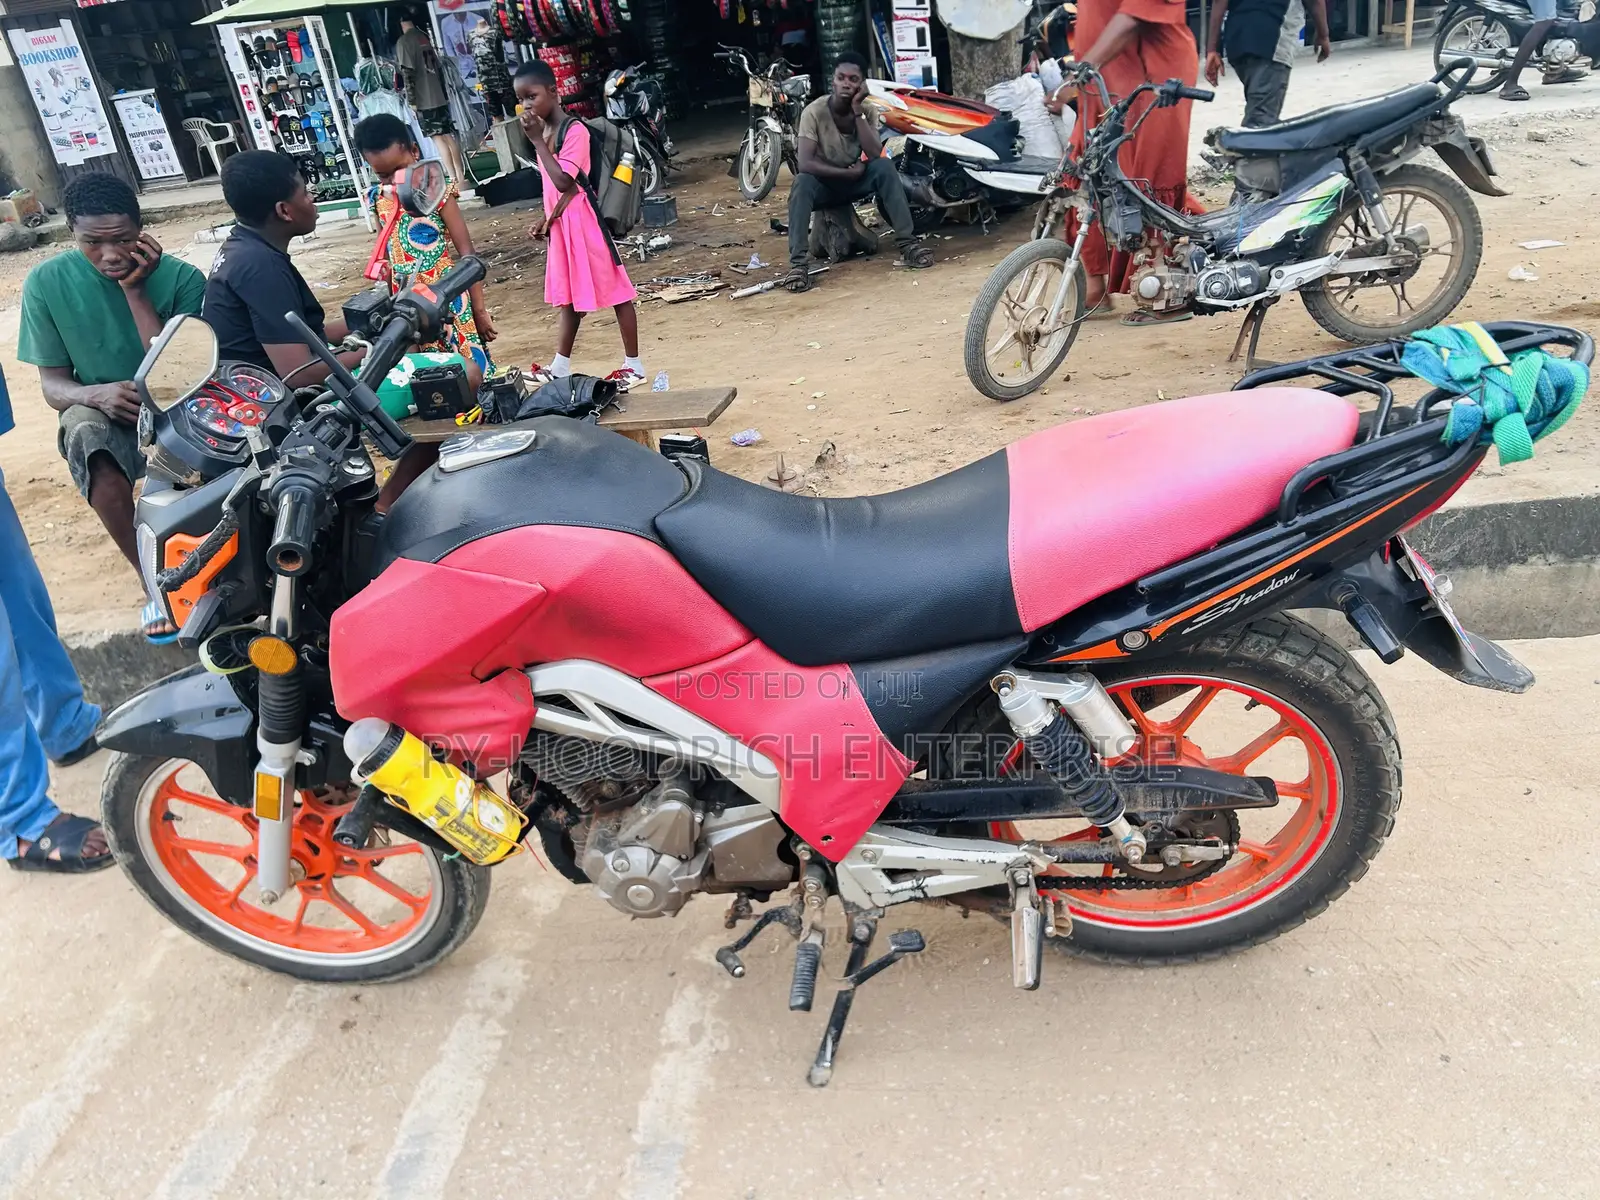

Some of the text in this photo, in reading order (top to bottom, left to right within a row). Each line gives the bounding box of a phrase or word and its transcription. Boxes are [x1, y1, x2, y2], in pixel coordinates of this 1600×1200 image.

[31, 35, 57, 46] BIGSAM
[19, 45, 79, 66] BOOKSHOP
[1181, 568, 1300, 635] Shadow
